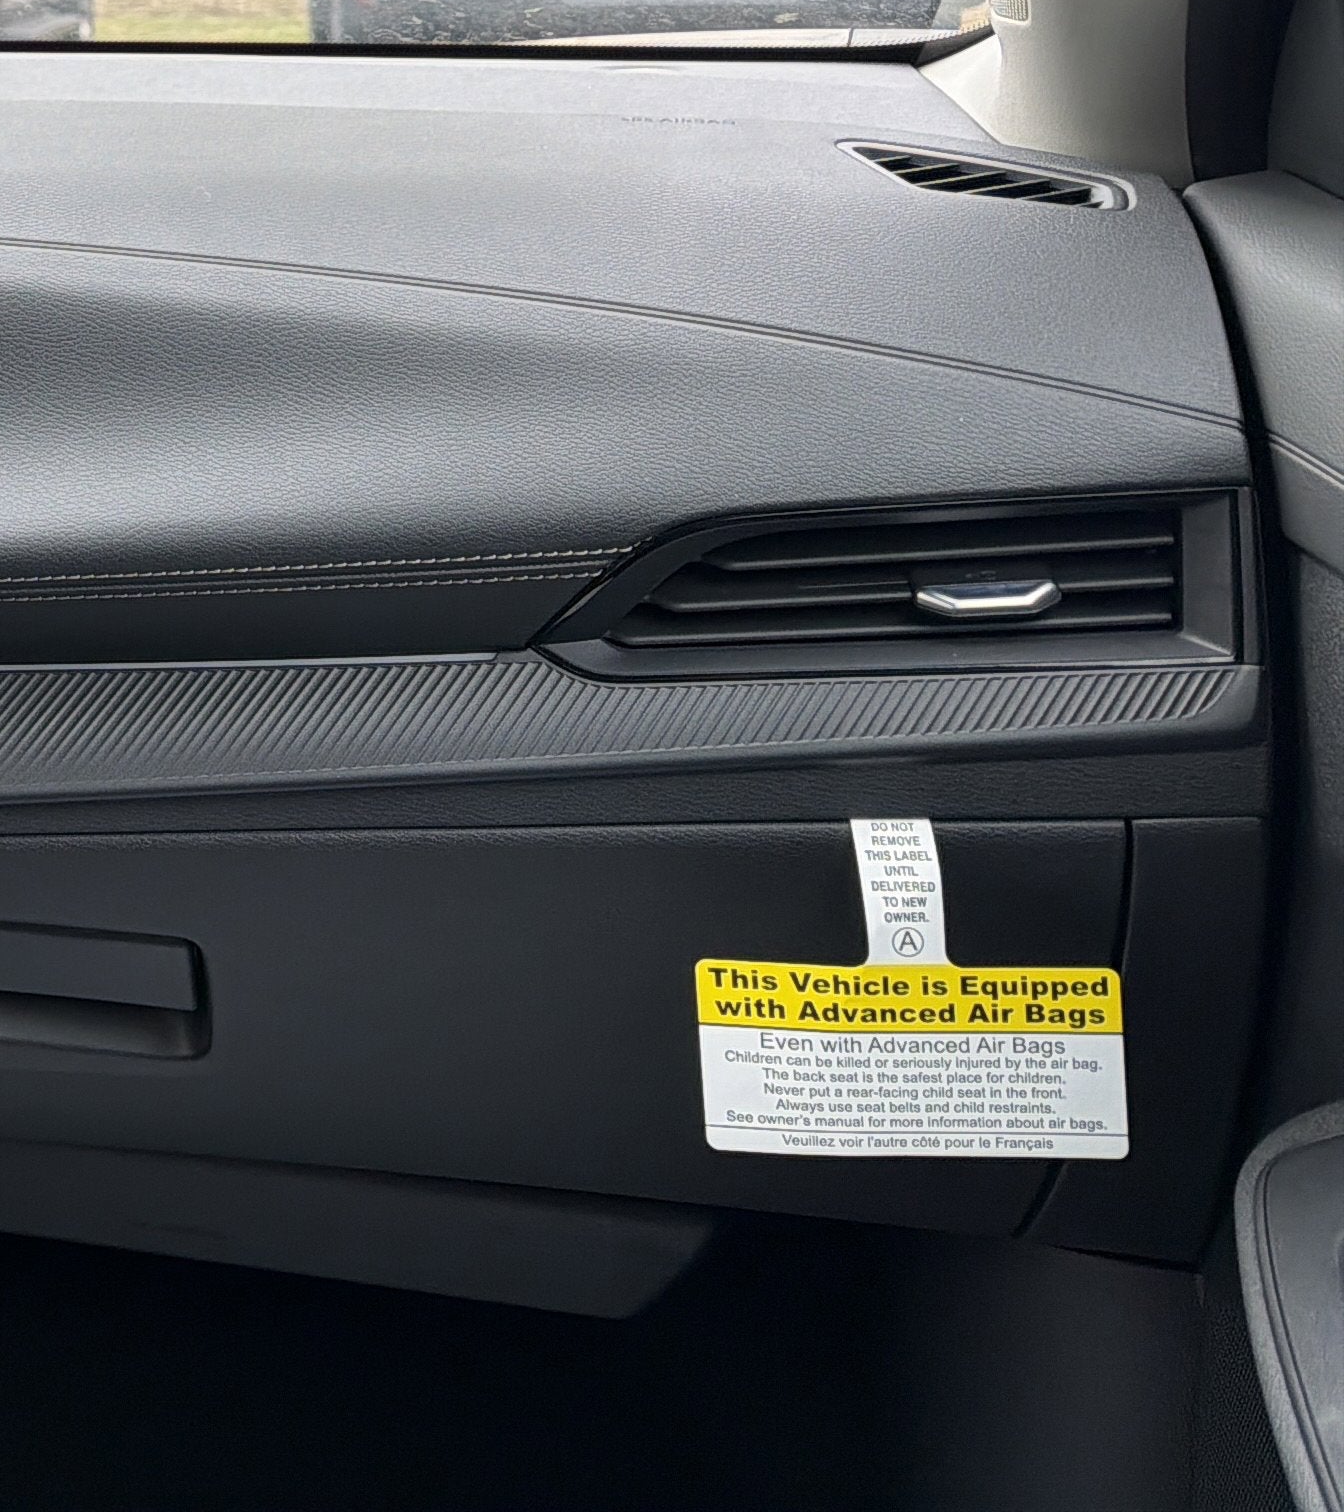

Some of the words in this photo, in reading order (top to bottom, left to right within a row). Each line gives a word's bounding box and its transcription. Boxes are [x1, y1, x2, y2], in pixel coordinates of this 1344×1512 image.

[871, 823, 888, 832] DO
[892, 823, 914, 832] NOT
[871, 836, 920, 846] REMOVE
[864, 850, 891, 861] THIS
[894, 851, 932, 861] LABEL
[884, 866, 918, 876] UNTIL
[871, 881, 936, 892] DELIVERED
[882, 896, 898, 907] TO
[902, 897, 927, 907] NEW
[884, 912, 929, 922] OWNER.
[899, 931, 918, 951] A
[708, 968, 778, 991] This
[789, 972, 909, 995] Vehicle
[921, 976, 948, 996] is
[960, 976, 1109, 1000] Equipped
[715, 997, 786, 1019] with
[798, 1001, 956, 1023] Advanced
[968, 1003, 1014, 1023] Air
[1025, 1004, 1105, 1028] Bags
[760, 1032, 812, 1051] Even
[821, 1037, 861, 1053] with
[868, 1037, 970, 1054] Advanced
[976, 1037, 1006, 1053] Air
[1013, 1037, 1065, 1058] Bags
[725, 1050, 782, 1065] Children
[787, 1056, 811, 1067] can
[816, 1057, 832, 1068] be
[837, 1057, 870, 1068] killed
[875, 1059, 888, 1068] or
[893, 1058, 951, 1070] seriously
[956, 1057, 1000, 1071] injured
[1005, 1058, 1021, 1071] by
[1026, 1058, 1046, 1069] the
[1051, 1058, 1068, 1069] air
[1073, 1059, 1102, 1072] bag.
[762, 1068, 789, 1080] The
[793, 1069, 825, 1082] back
[830, 1071, 858, 1083] seat
[863, 1071, 873, 1083] is
[877, 1072, 898, 1083] the
[903, 1072, 942, 1083] safest
[947, 1073, 982, 1086] place
[986, 1072, 1005, 1084] for
[1008, 1073, 1066, 1084] children.
[764, 1083, 805, 1096] Never
[810, 1086, 830, 1100] put
[835, 1089, 842, 1097] a
[847, 1087, 918, 1099] rear-facing
[923, 1088, 953, 1099] child
[957, 1089, 986, 1099] seat
[990, 1088, 1002, 1099] in
[1007, 1088, 1027, 1099] the
[1032, 1088, 1066, 1099] front.
[776, 1099, 824, 1114] Always
[829, 1103, 852, 1112] use
[857, 1102, 885, 1112] seat
[890, 1101, 920, 1113] belts
[925, 1103, 950, 1113] and
[954, 1103, 984, 1113] child
[989, 1103, 1056, 1114] restraints.
[727, 1110, 753, 1123] See
[758, 1115, 811, 1126] owner's
[815, 1117, 864, 1127] manual
[869, 1116, 886, 1127] for
[890, 1119, 923, 1128] more
[928, 1118, 1002, 1129] information
[1007, 1118, 1044, 1129] about
[1049, 1119, 1066, 1129] air
[1070, 1119, 1107, 1132] bags.
[782, 1134, 835, 1147] Veuillez
[839, 1136, 864, 1147] voir
[868, 1136, 907, 1148] l'autre
[912, 1136, 940, 1148] côté
[945, 1139, 974, 1152] pour
[979, 1138, 990, 1148] le
[996, 1138, 1054, 1150] Français
